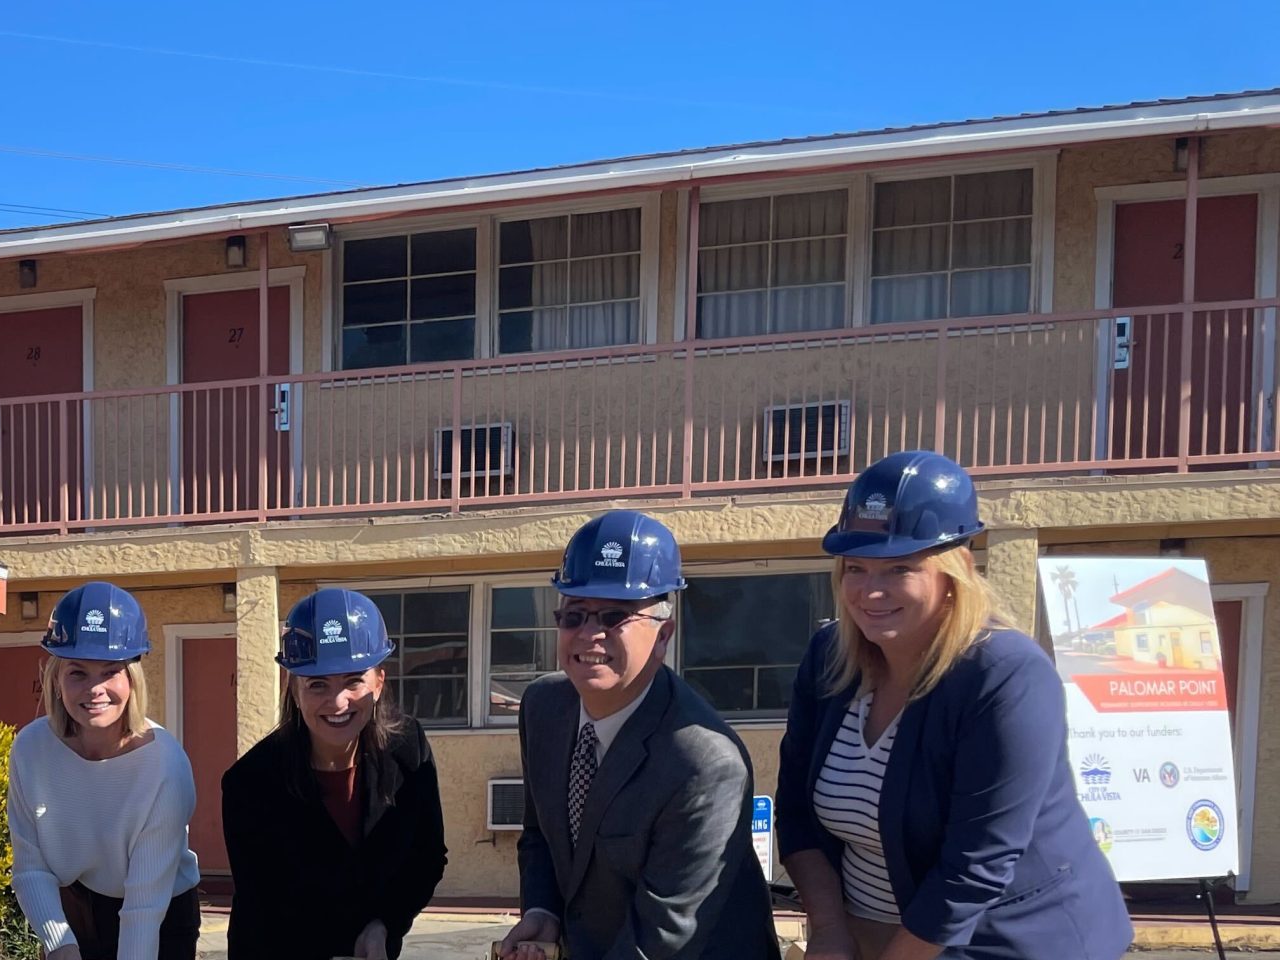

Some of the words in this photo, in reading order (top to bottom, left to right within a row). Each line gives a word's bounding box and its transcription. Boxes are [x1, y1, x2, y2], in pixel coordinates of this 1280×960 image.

[228, 327, 243, 343] 27
[26, 347, 40, 360] 28
[1109, 680, 1176, 696] PALOMAR
[1179, 680, 1217, 695] POINT
[1099, 730, 1115, 741] you
[1117, 727, 1128, 737] to
[1129, 729, 1144, 737] our
[1146, 725, 1182, 737] funders:
[1133, 768, 1151, 783] VA
[1102, 792, 1121, 801] VISTA
